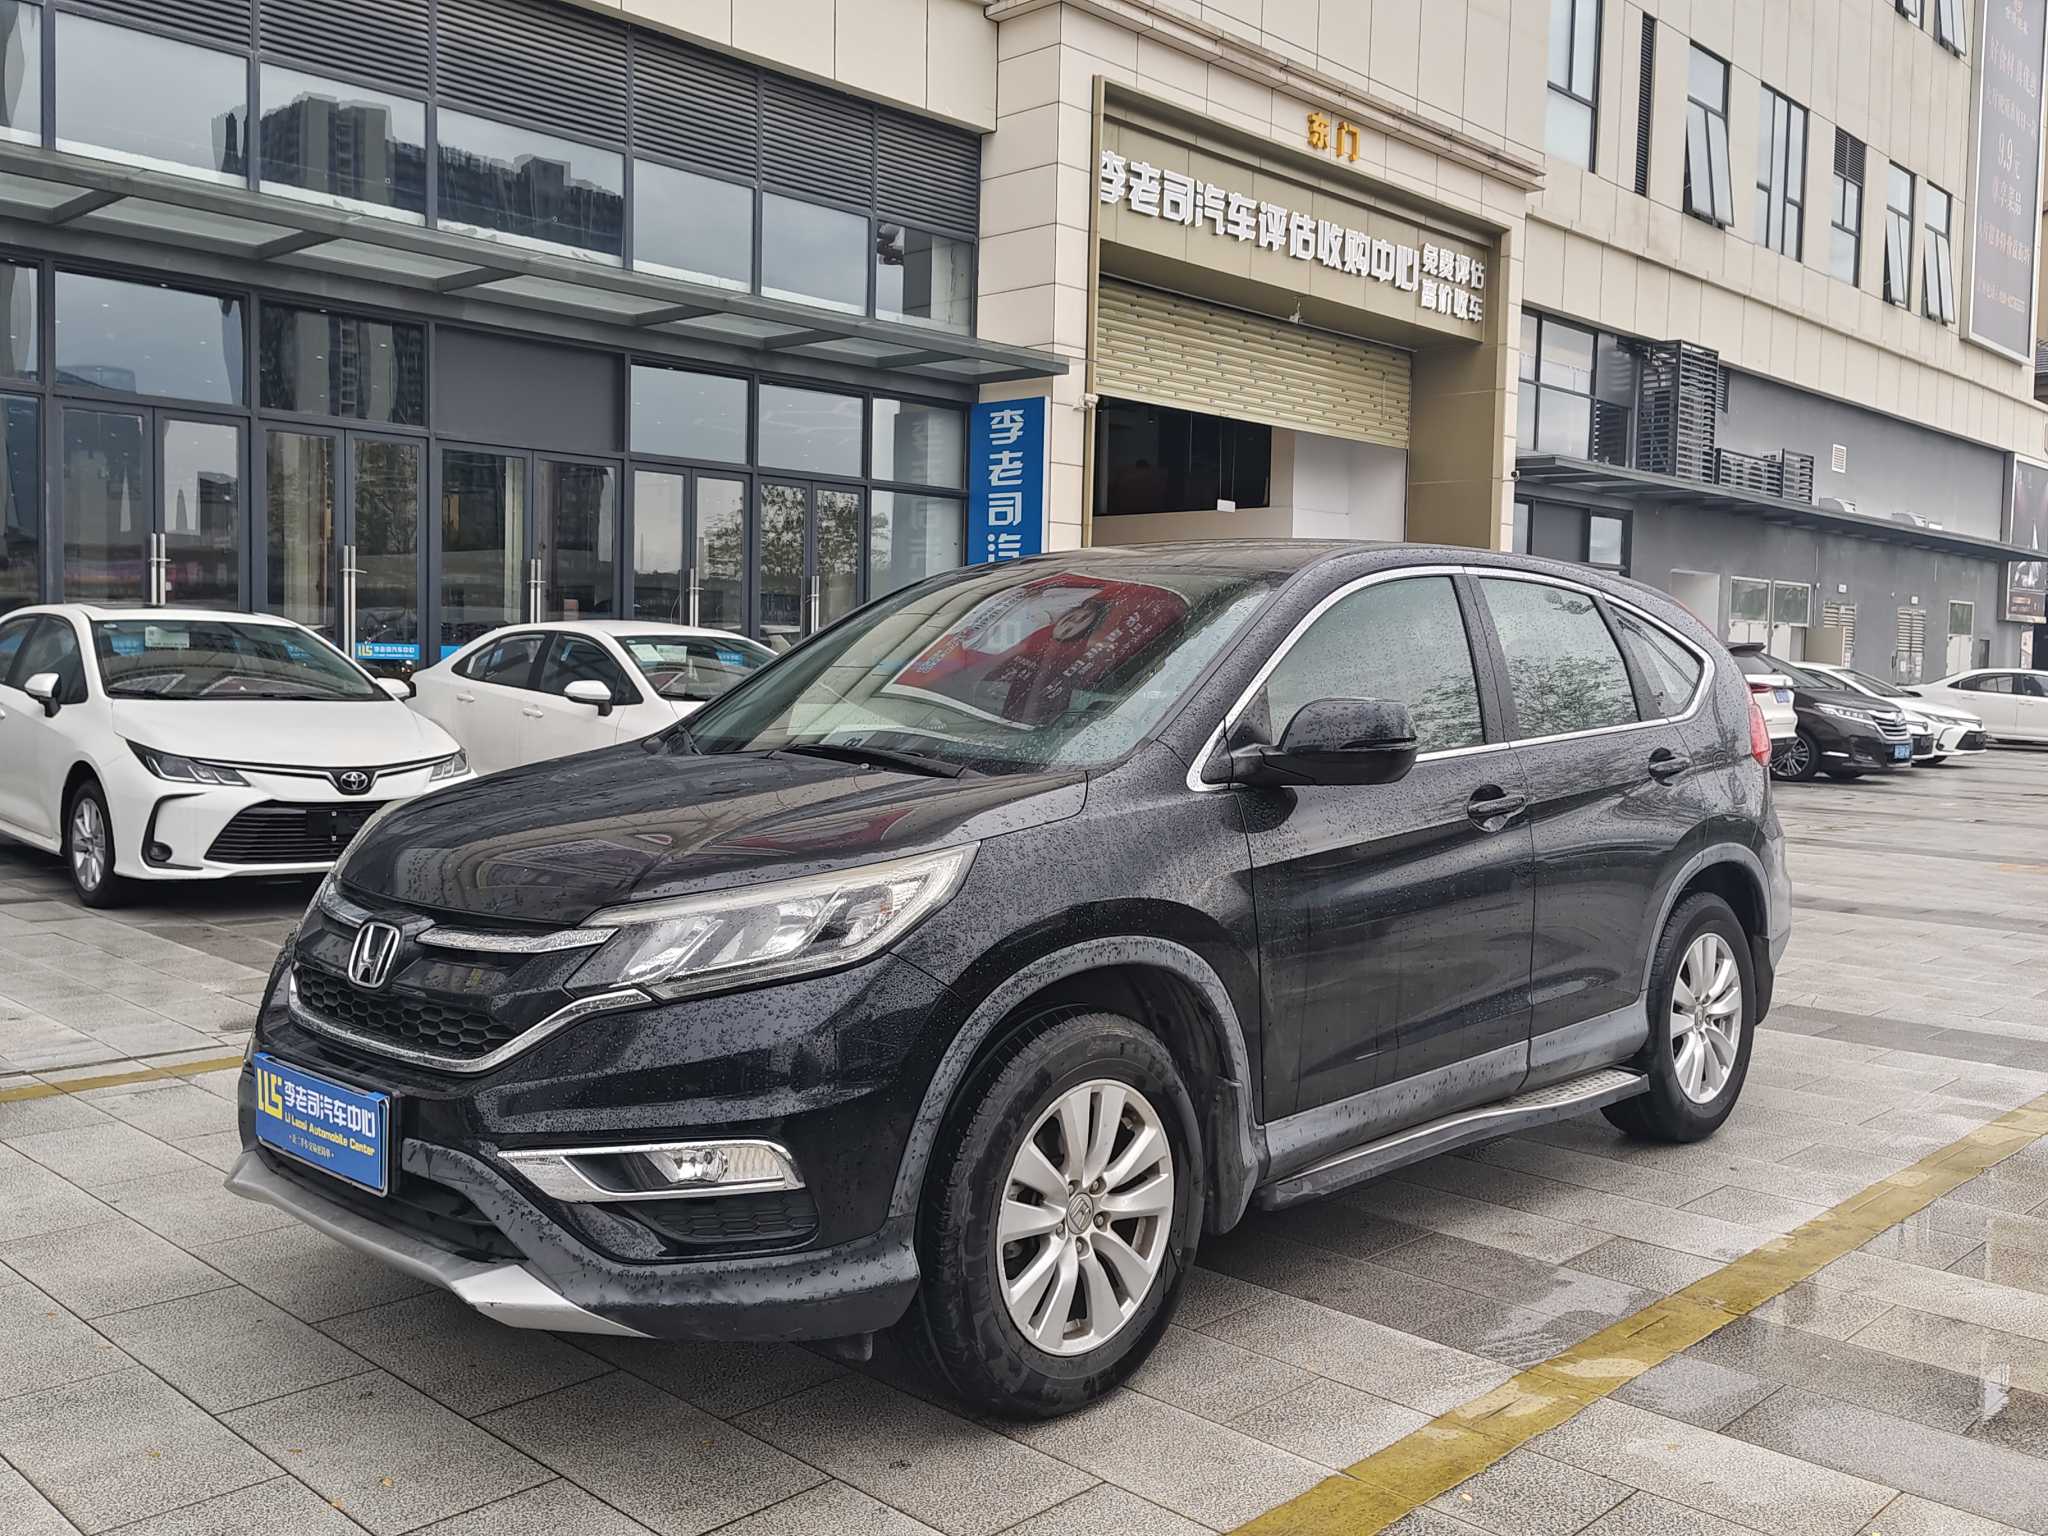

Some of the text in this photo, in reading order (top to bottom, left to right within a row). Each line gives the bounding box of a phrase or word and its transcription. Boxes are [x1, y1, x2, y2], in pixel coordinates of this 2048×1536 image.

[1307, 112, 1361, 162] 东门
[1100, 149, 1419, 293] 李老司汽车评估收购中心
[1422, 242, 1485, 289] 免费评估
[1421, 278, 1483, 322] 高价收车
[284, 1080, 376, 1138] 李老司汽车中心
[308, 1122, 348, 1147] Automobile
[349, 1137, 376, 1156] Center
